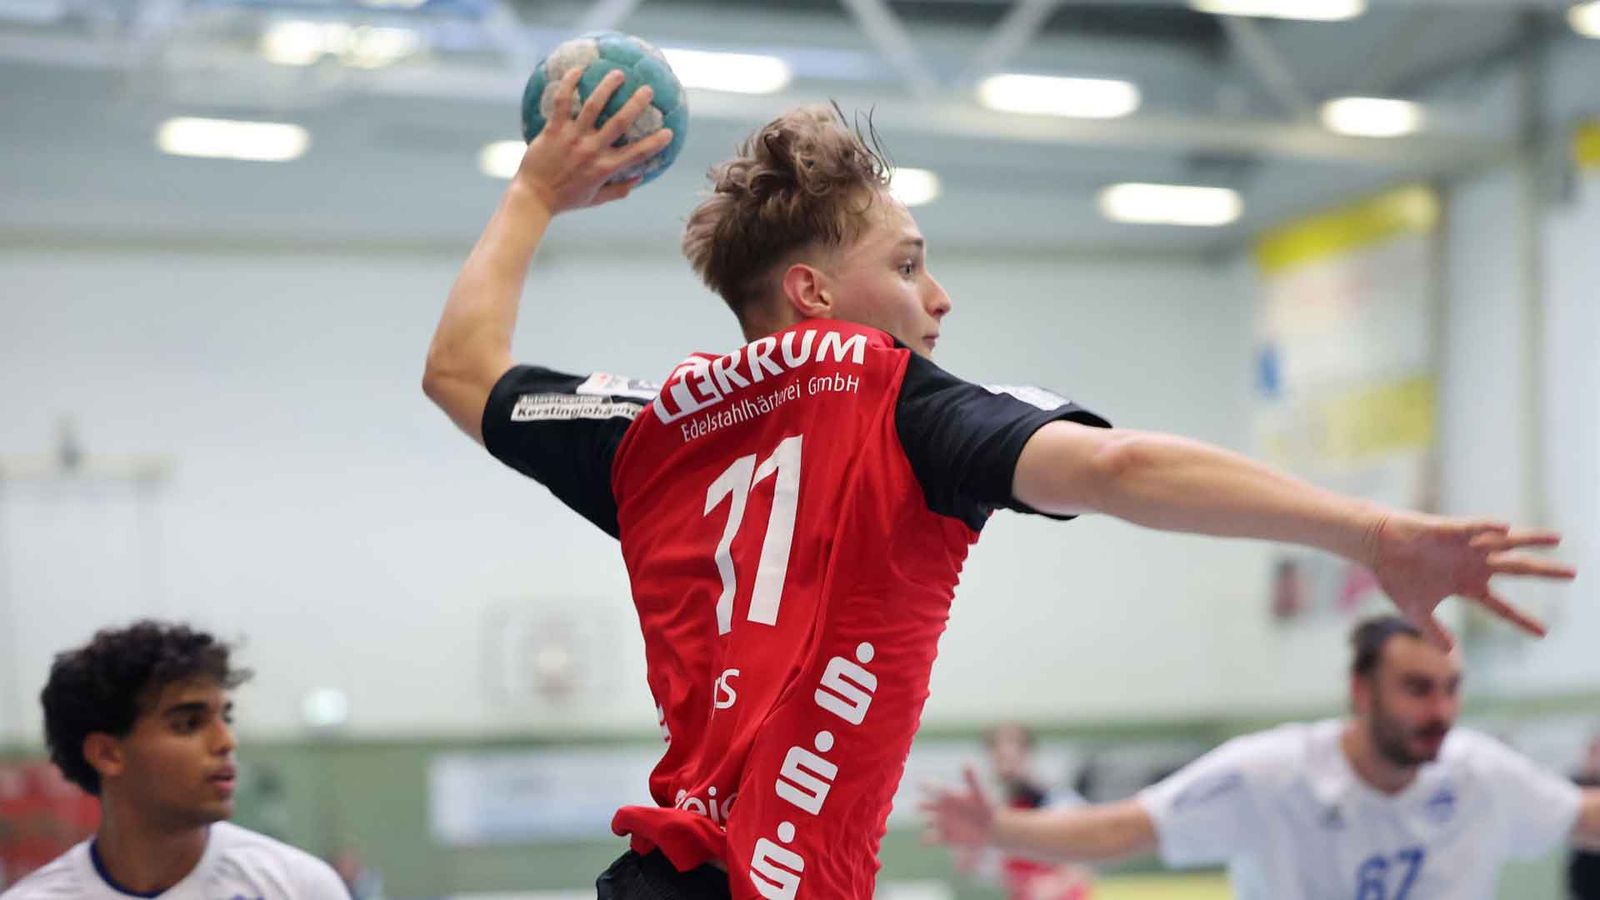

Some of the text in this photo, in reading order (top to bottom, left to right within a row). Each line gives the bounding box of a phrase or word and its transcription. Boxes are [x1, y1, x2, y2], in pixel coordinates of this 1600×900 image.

[808, 372, 860, 396] GmbH
[703, 433, 803, 636] 11
[1355, 847, 1425, 900] 67
